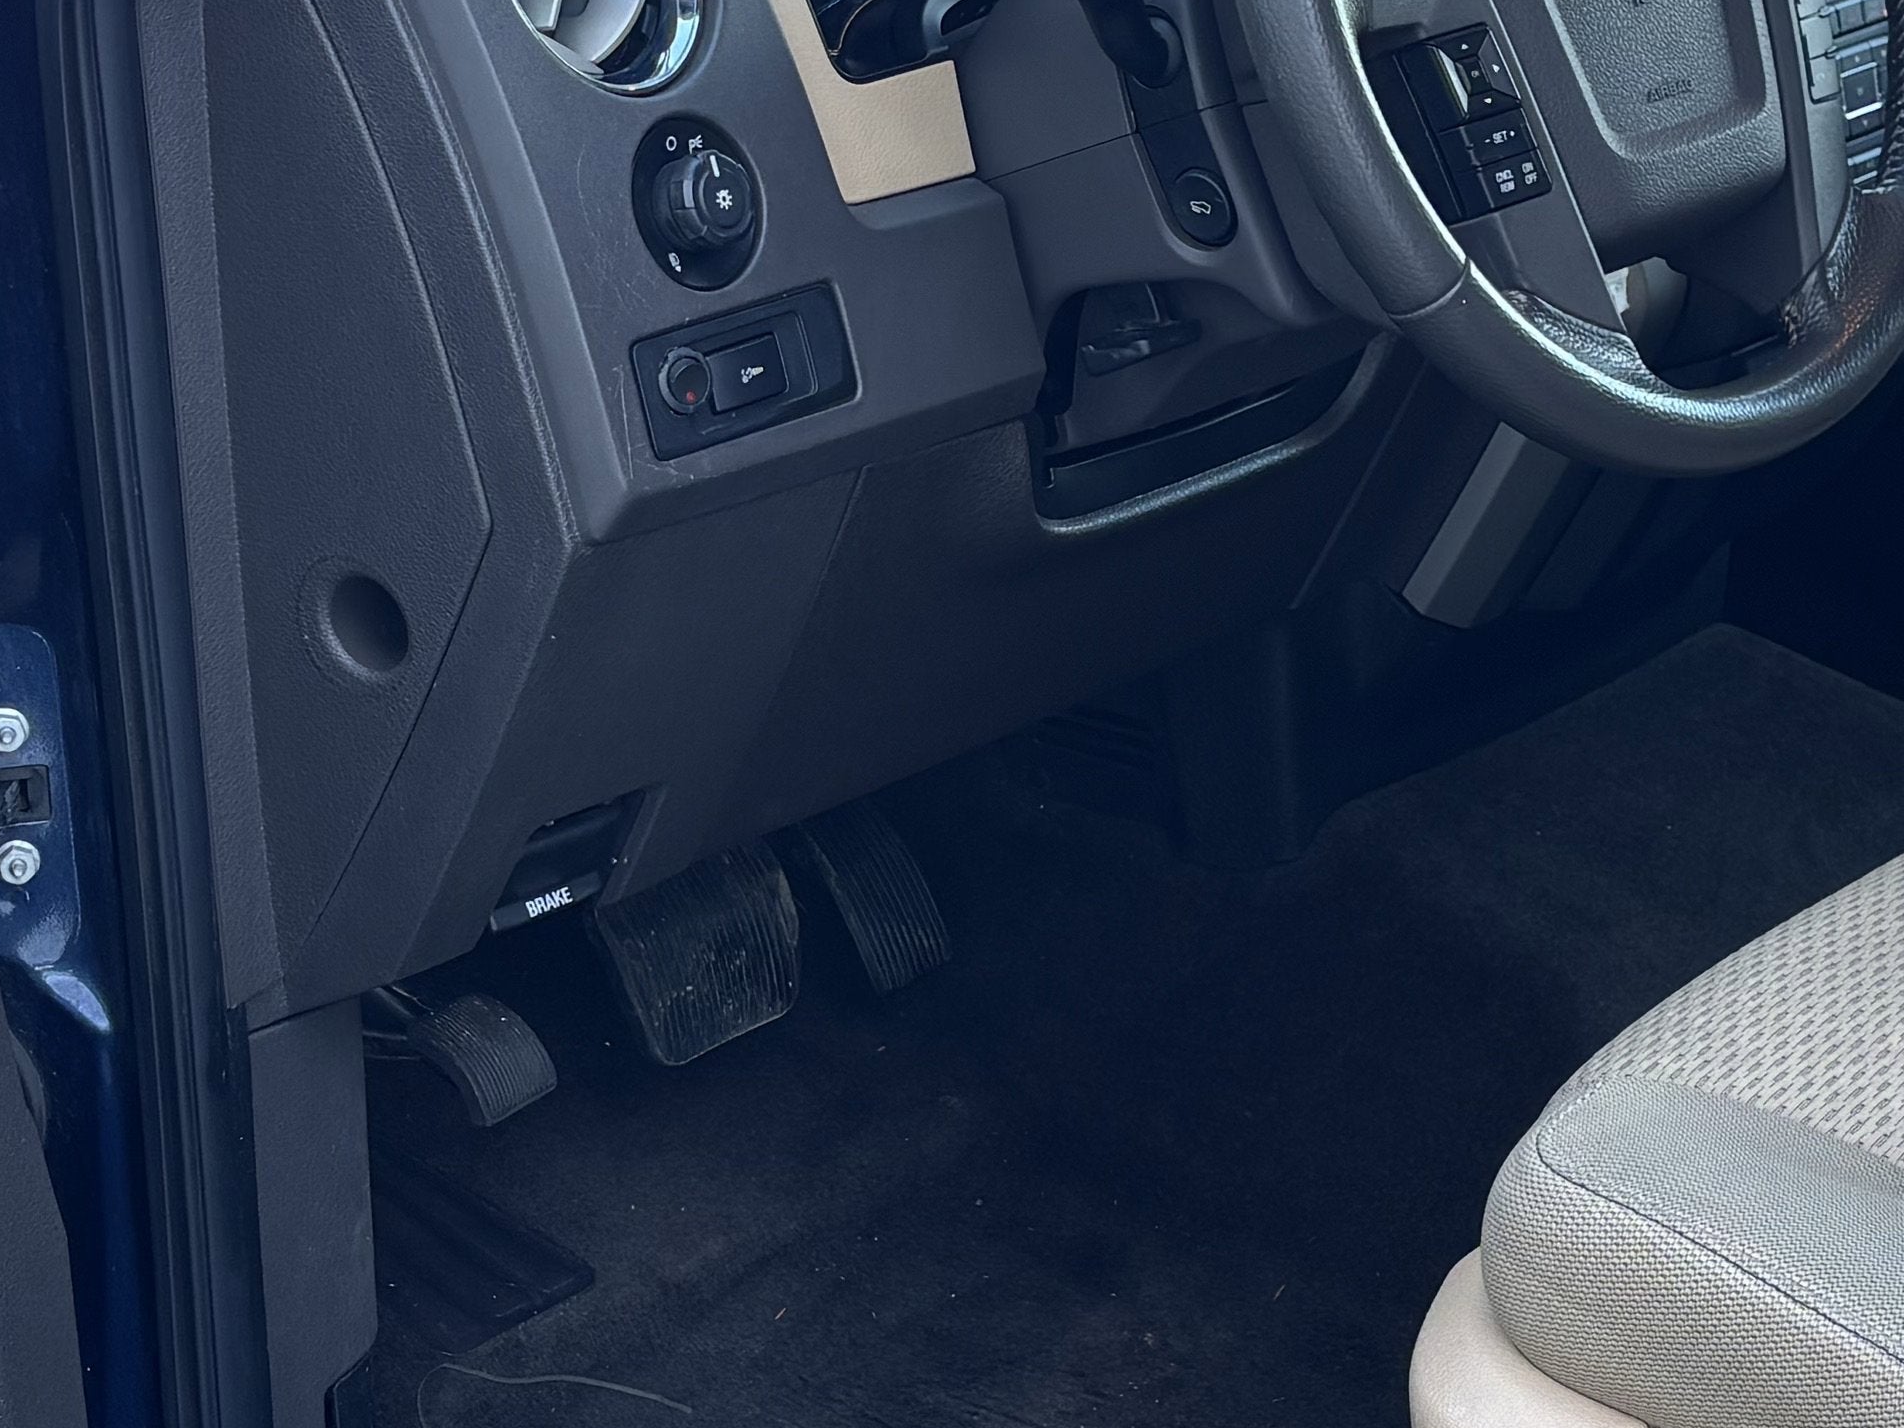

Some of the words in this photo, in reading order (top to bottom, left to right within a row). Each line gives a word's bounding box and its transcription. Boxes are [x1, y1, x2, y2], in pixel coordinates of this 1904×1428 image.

[1647, 79, 1694, 103] AIRBAG
[1525, 172, 1538, 185] OFF
[525, 886, 573, 918] BRAKE
